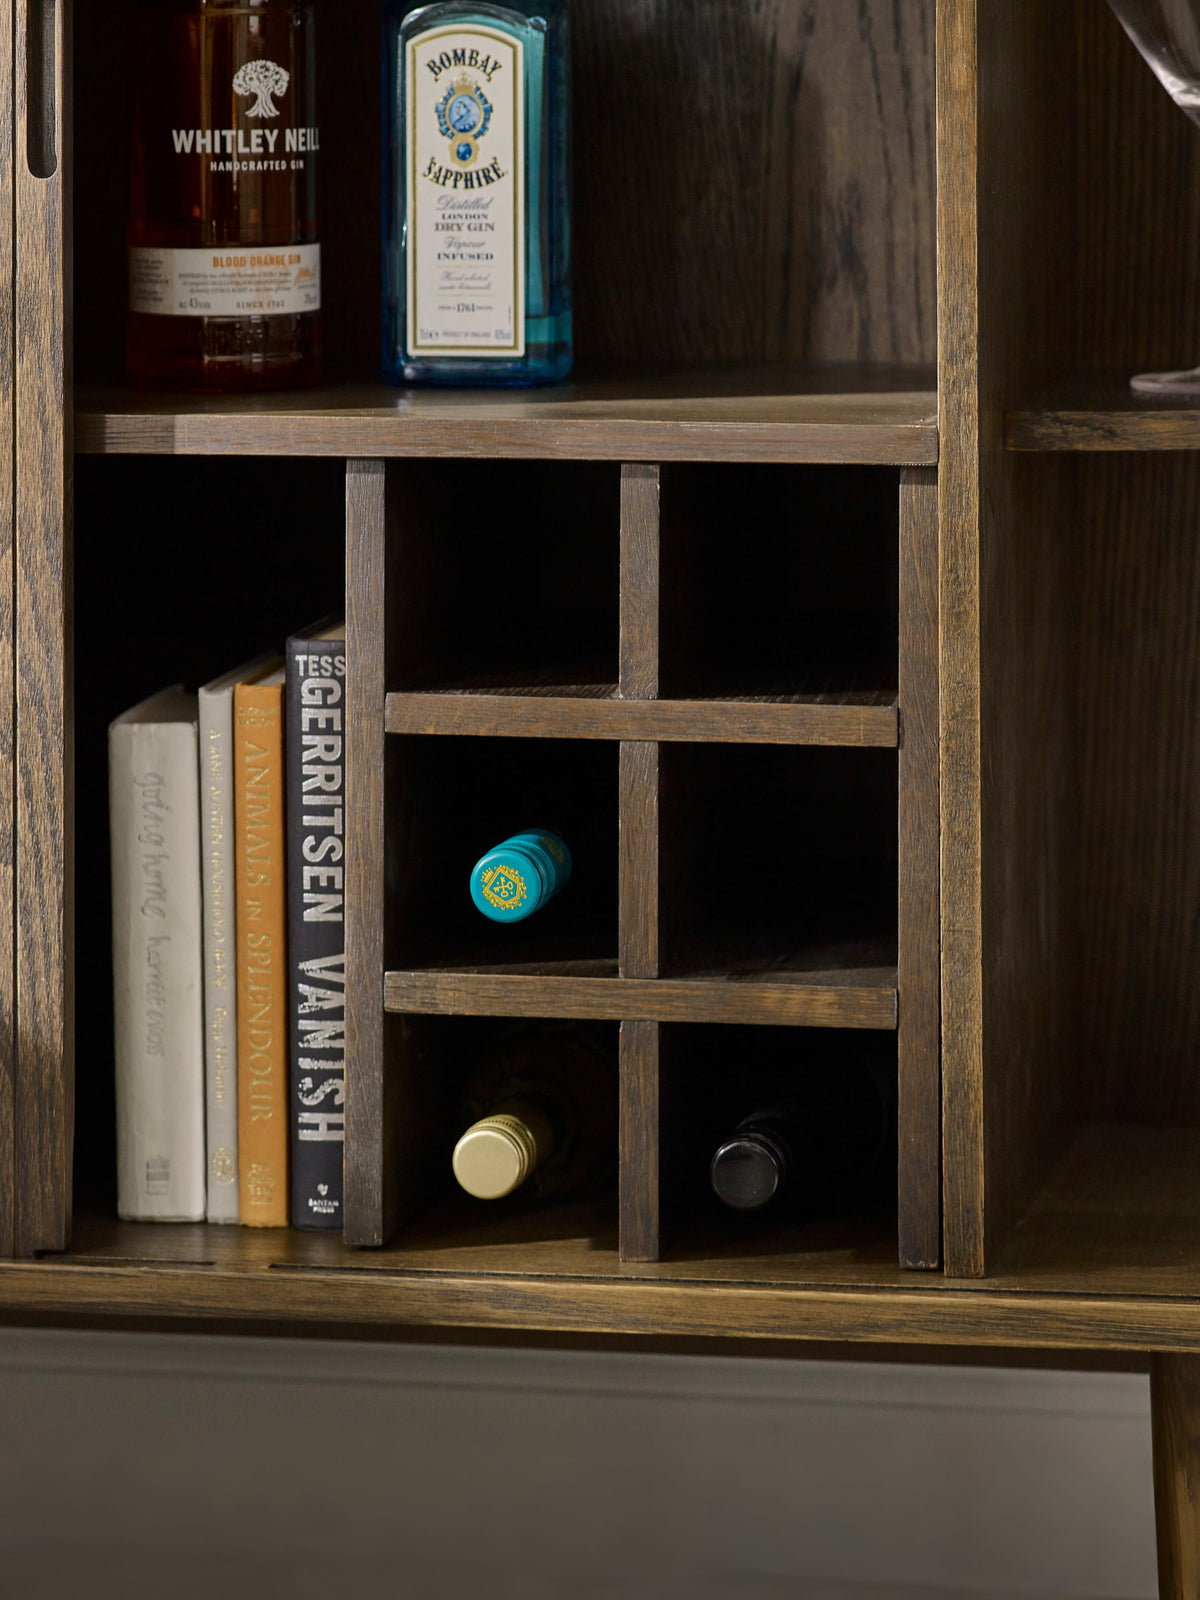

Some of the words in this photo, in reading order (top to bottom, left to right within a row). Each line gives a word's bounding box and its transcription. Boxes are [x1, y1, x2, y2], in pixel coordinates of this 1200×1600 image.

[425, 48, 503, 82] BOMBAY
[172, 129, 279, 154] WHITLEY
[210, 160, 287, 172] HANDCRAFTED
[290, 160, 304, 170] GIN
[422, 156, 505, 190] SAPPHIRE
[435, 194, 494, 211] Distilled
[434, 222, 464, 232] DRY
[466, 222, 495, 232] GIN
[212, 256, 247, 268] BLOOD
[250, 254, 286, 267] ORANGE
[288, 253, 302, 265] GIN
[437, 252, 494, 261] INFUSED
[456, 302, 475, 312] 1761
[295, 655, 346, 677] TESS
[301, 677, 344, 922] GERRITSEN
[244, 740, 272, 888] ANIMALS
[246, 899, 265, 921] IN
[247, 933, 273, 1122] SPLENDOUR
[298, 953, 345, 1142] VANISH
